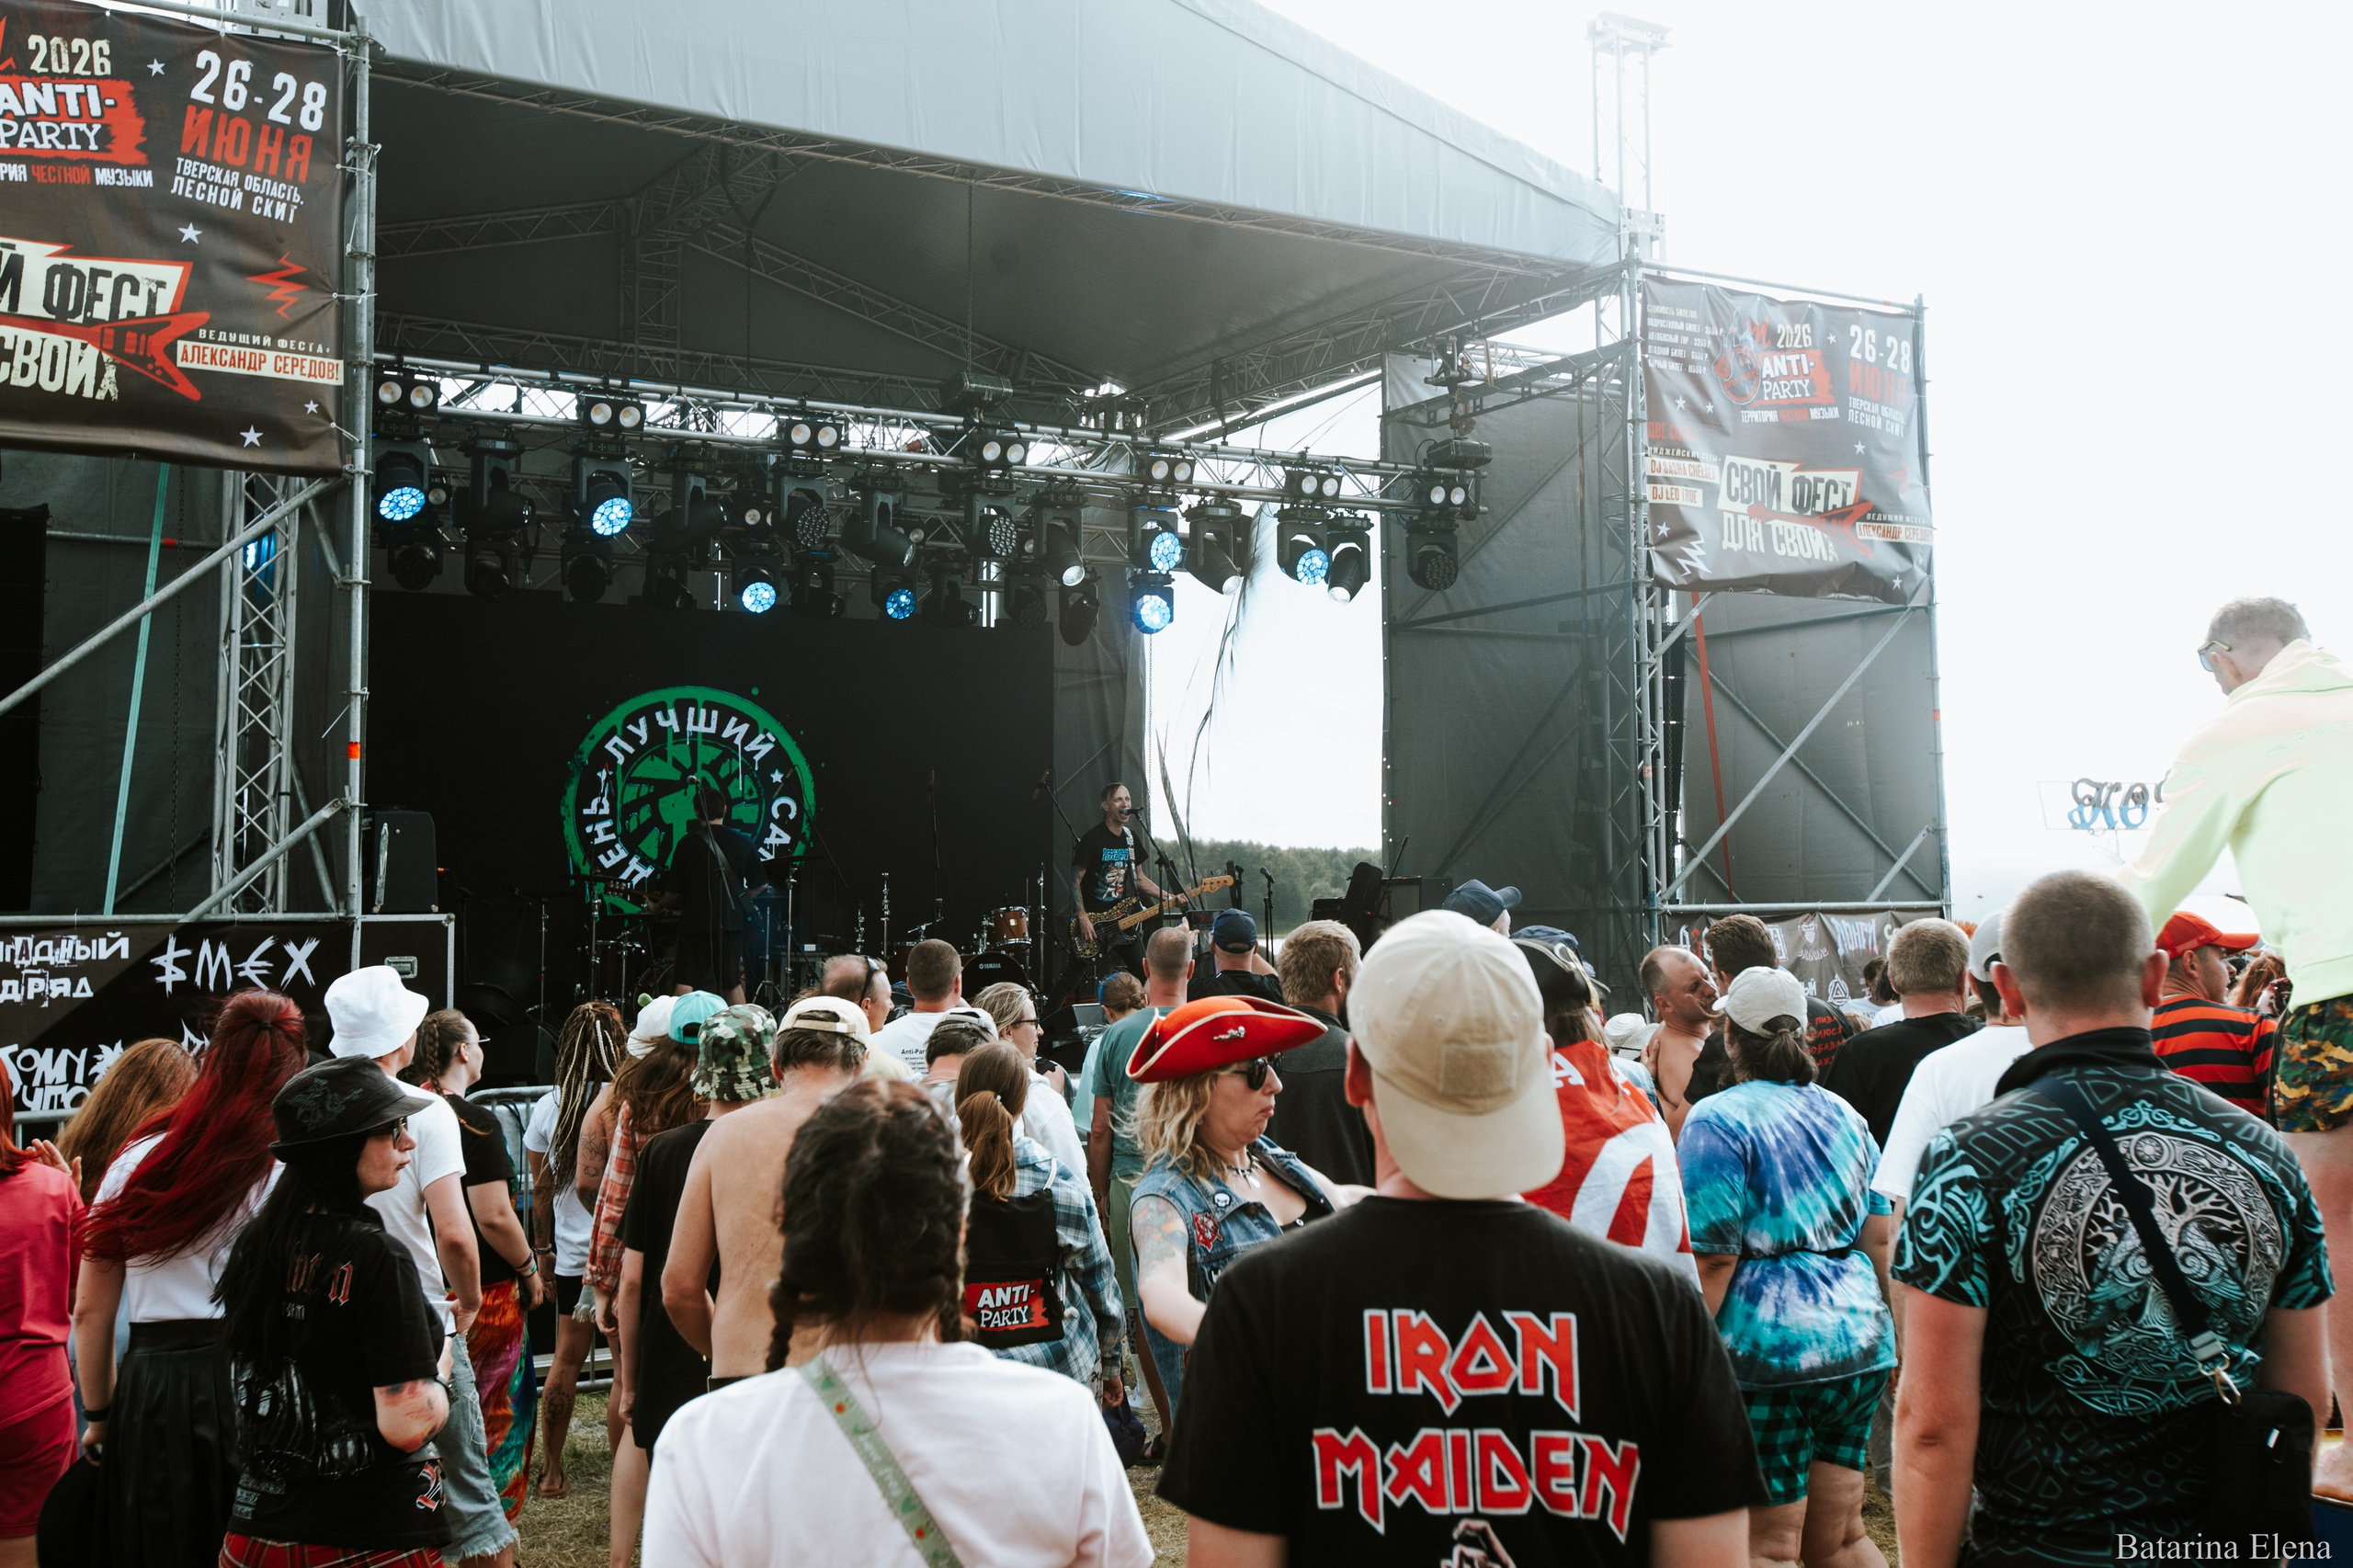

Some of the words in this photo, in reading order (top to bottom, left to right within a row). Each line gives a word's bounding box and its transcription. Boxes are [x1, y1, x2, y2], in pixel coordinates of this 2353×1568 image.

[28, 34, 111, 76] 2026
[0, 118, 102, 152] PARTY
[180, 105, 313, 185] ИЮНЯ
[31, 164, 91, 185] ЧЕСТНОЙ
[95, 167, 154, 188] МУЗЫКИ
[176, 156, 241, 188] ТВЕРСКАЯ
[170, 176, 244, 210] ЛЕСНОЙ
[252, 195, 299, 224] СКИТ
[42, 262, 167, 326] ФЕСТ
[199, 328, 272, 347] ВЕДУЩИЙ
[1777, 323, 1813, 349] 2026
[1849, 324, 1911, 375] 26-28
[180, 344, 267, 372] АЛЕКСАНДР
[273, 355, 339, 381] СЕРЕДОВ!
[1762, 379, 1811, 402] PARTY
[1848, 359, 1909, 410] ИЮНЯ
[1740, 409, 1779, 424] ТЕРРИТОРИЯ
[1810, 405, 1840, 420] МУЗЫКИ
[1847, 396, 1880, 415] ТВЕРСКАЯ
[1647, 421, 1667, 440] ДВЕ
[1847, 409, 1882, 430] ЛЕСНОЙ
[1885, 419, 1904, 438] СКИТ
[1651, 459, 1662, 474] DJ
[1662, 460, 1688, 477] SASHA
[1652, 485, 1664, 500] DJ
[1665, 486, 1680, 502] LEO
[1681, 488, 1699, 505] TRUE
[1725, 461, 1782, 511] СВОЙ
[1791, 473, 1852, 516] ФЕСТ
[1722, 512, 1766, 553] ДЛЯ
[1858, 523, 1903, 540] АЛЕКСАНДР
[1866, 512, 1904, 523] ВЕДУЩИЙ
[604, 707, 777, 770] ЛУЧШИЙ
[980, 1305, 1029, 1328] PARTY
[1363, 1309, 1580, 1424] IRON
[1312, 1426, 1641, 1545] MAIDEN
